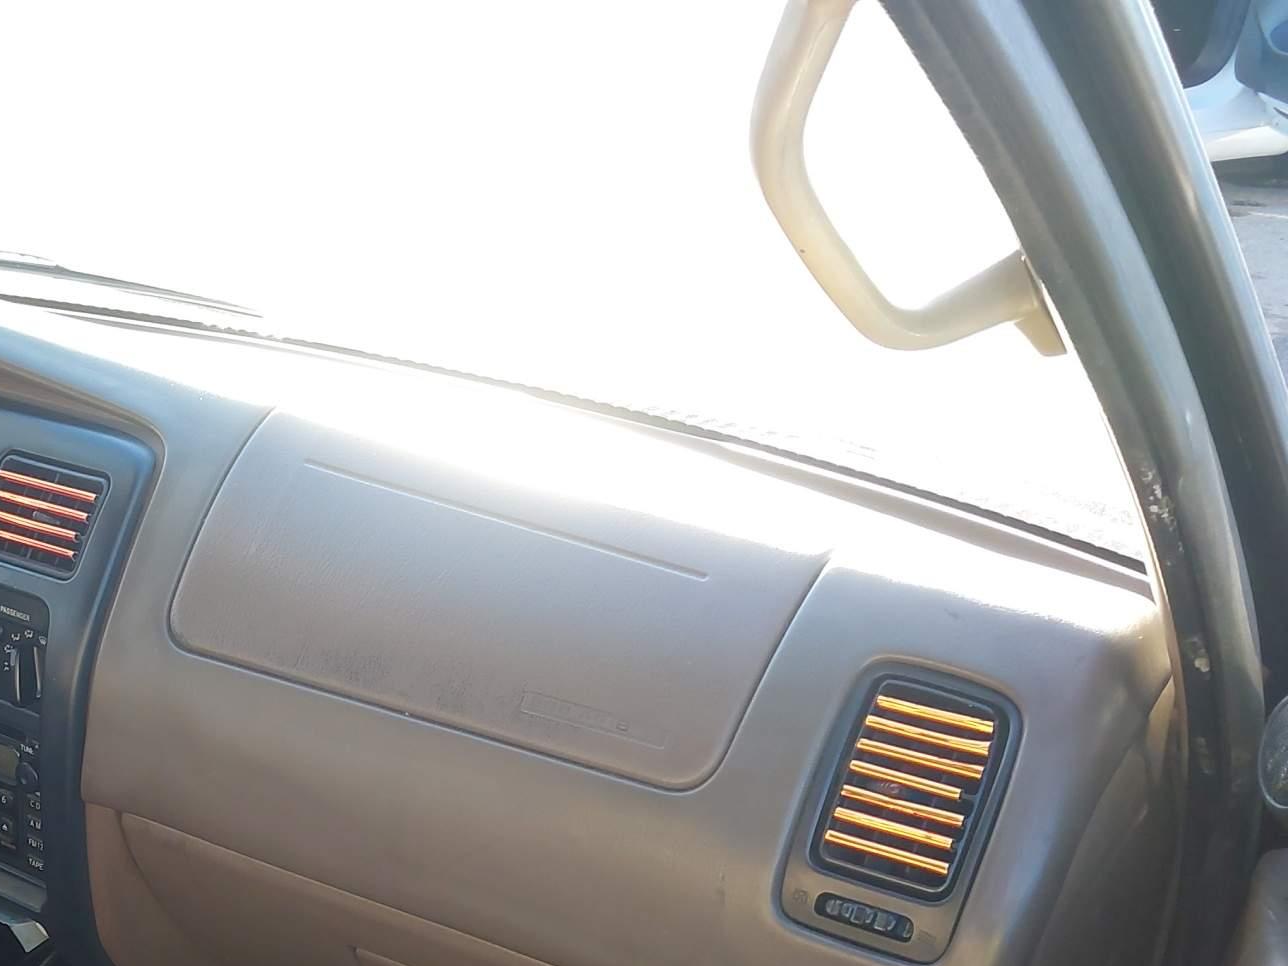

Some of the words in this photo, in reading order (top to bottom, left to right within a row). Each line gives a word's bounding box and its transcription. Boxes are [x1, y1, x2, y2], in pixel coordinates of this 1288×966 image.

[0, 605, 31, 622] PASSENGER
[1, 795, 7, 804] 6
[28, 857, 45, 871] TAPE
